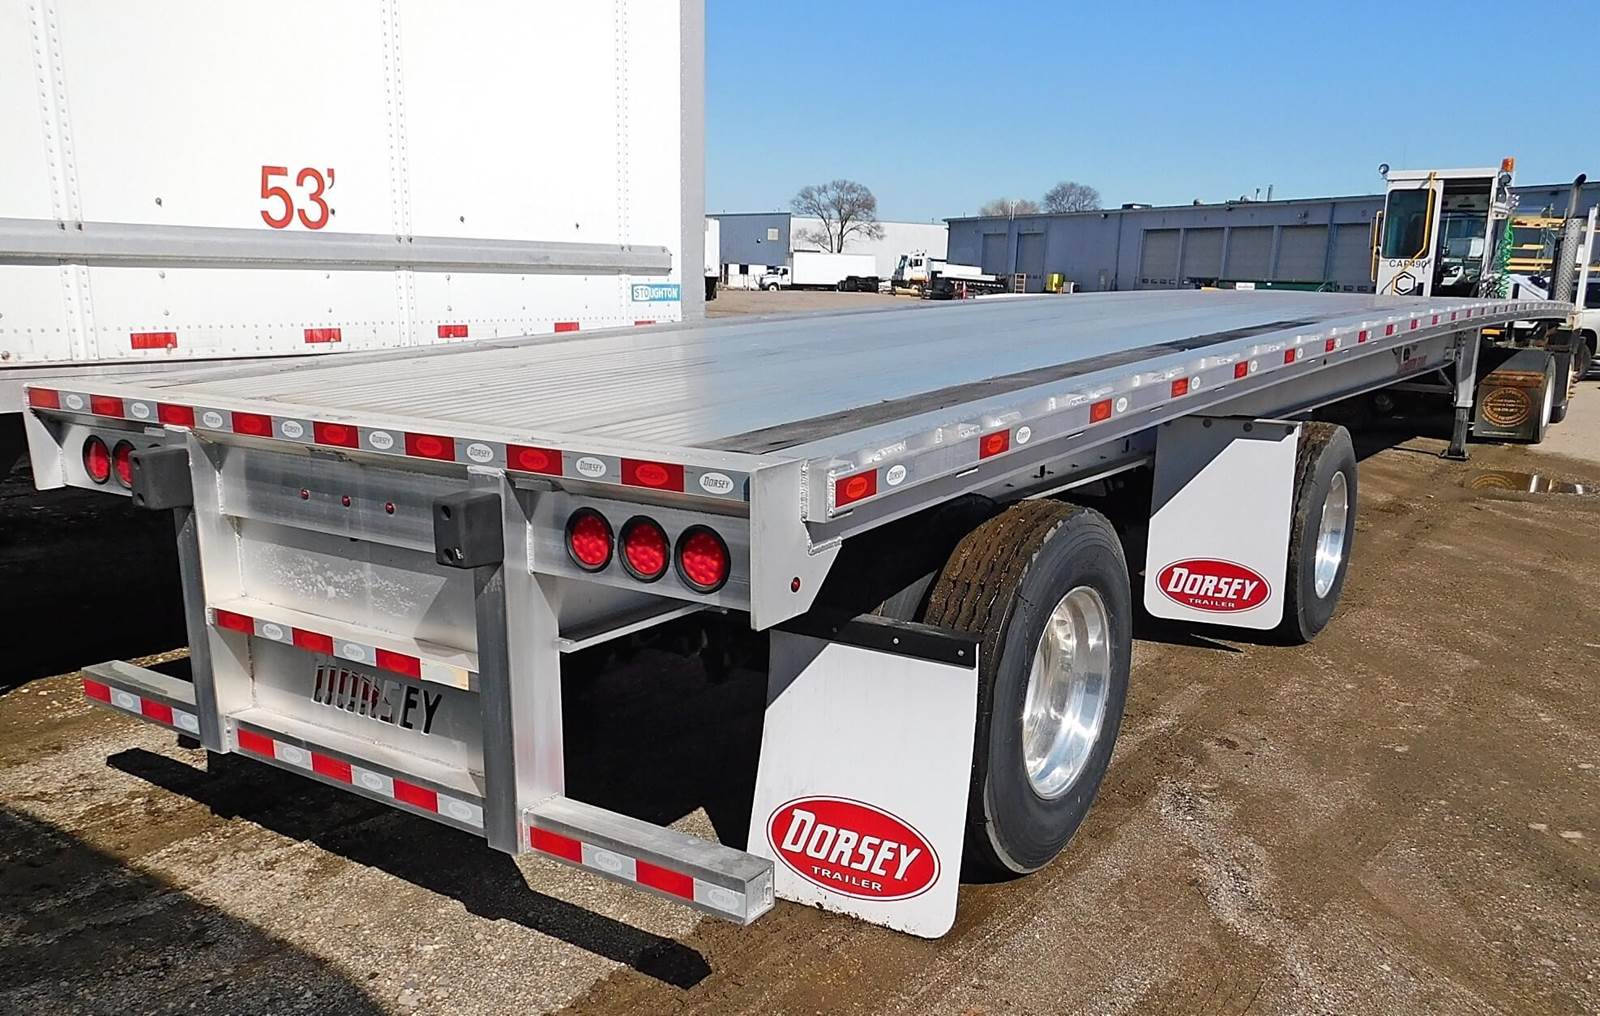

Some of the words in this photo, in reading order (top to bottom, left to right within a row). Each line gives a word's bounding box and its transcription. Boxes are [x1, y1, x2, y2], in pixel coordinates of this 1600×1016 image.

[260, 165, 335, 230] 53'
[634, 287, 679, 299] STOUGHTON
[579, 460, 602, 473] DORSEY
[703, 476, 730, 489] DORSEY
[1167, 567, 1259, 601] DORSEY
[1189, 598, 1235, 608] TRAILER
[780, 808, 922, 881] DORSEY
[812, 865, 883, 892] TRAILER
